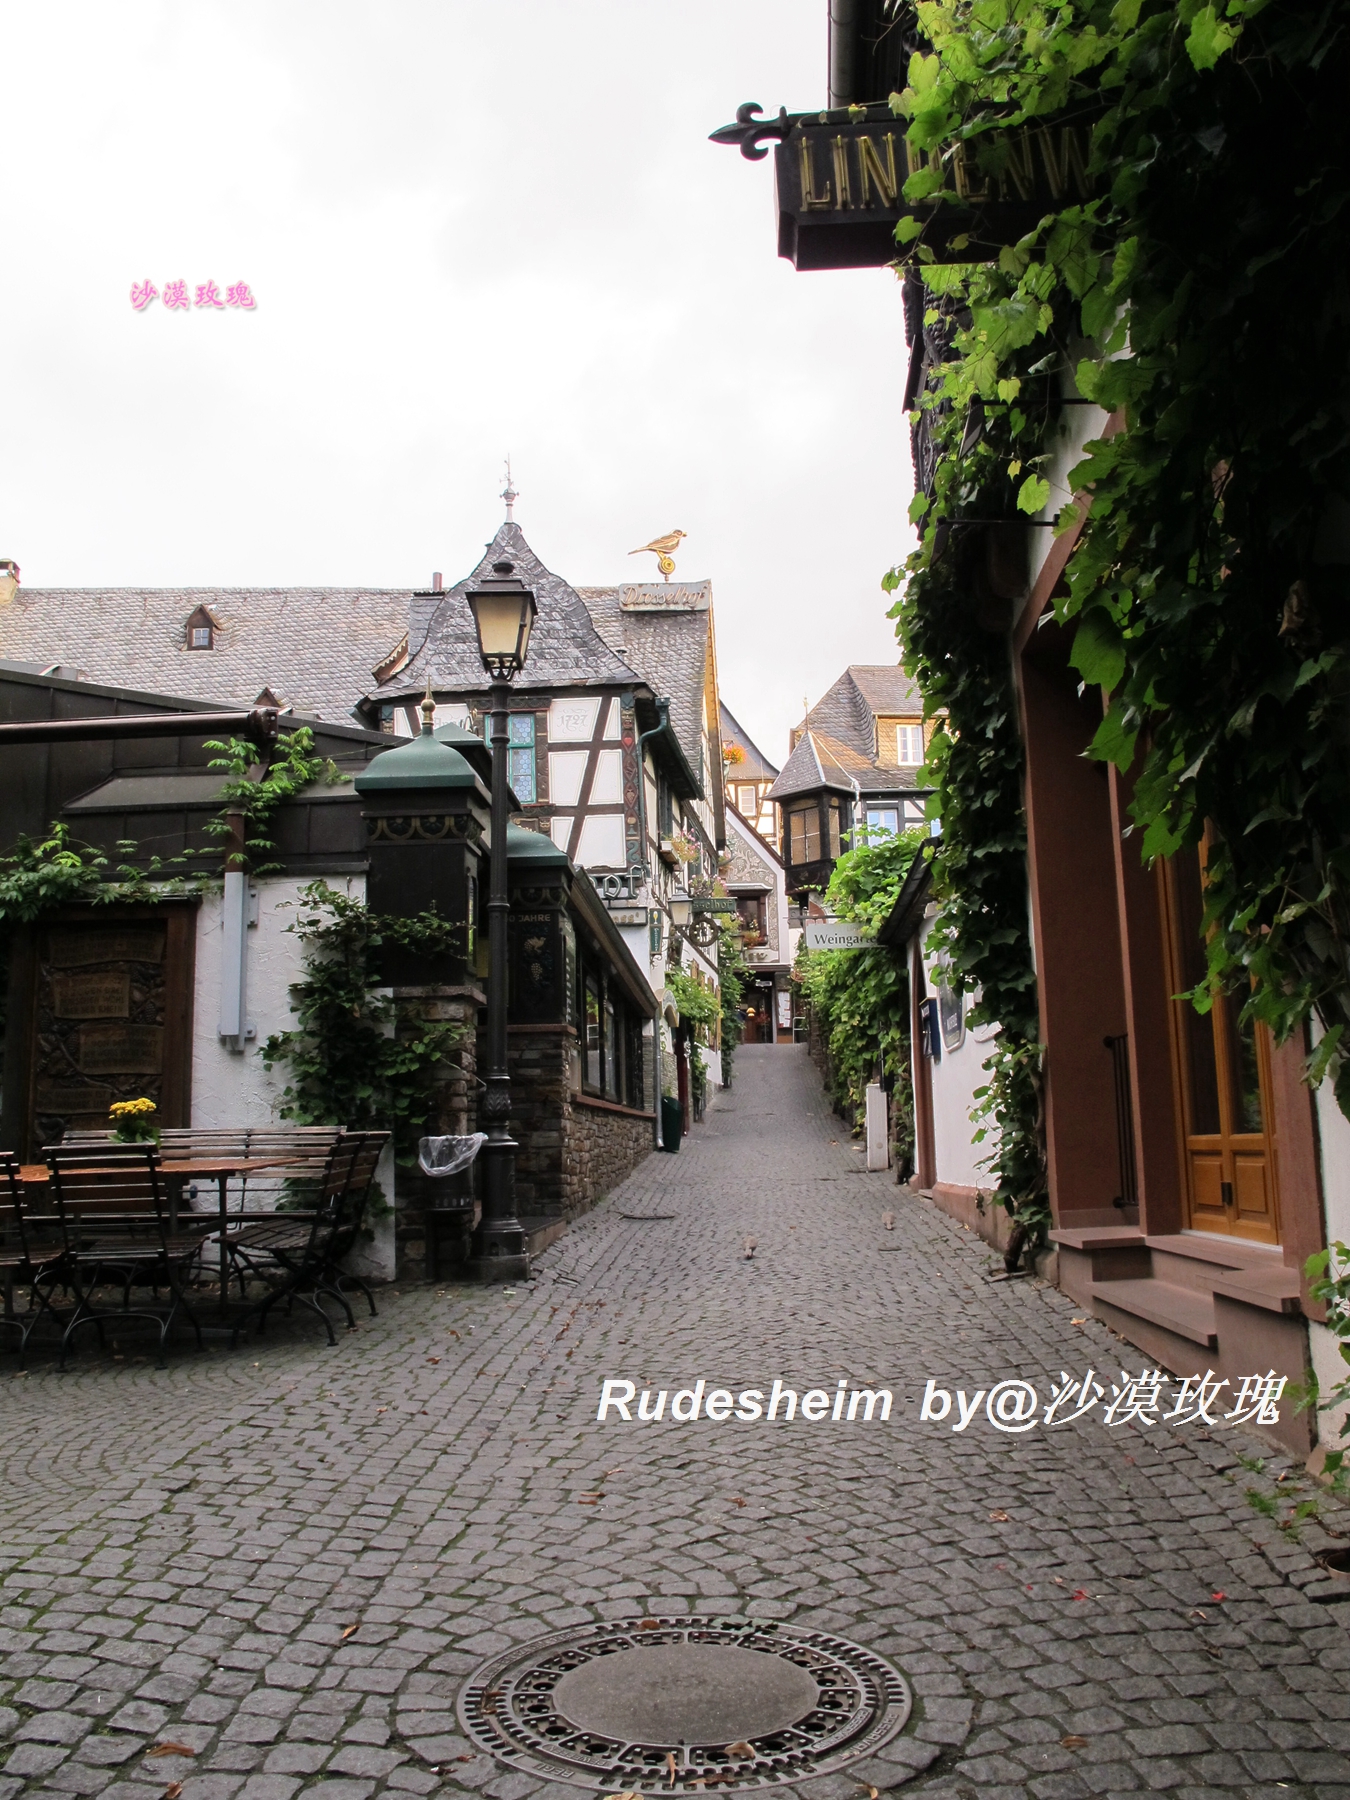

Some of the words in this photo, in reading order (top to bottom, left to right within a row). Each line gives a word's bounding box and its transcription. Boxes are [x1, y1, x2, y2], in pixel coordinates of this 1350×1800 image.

[621, 585, 703, 607] Drosselhof
[557, 714, 588, 731] 1727
[589, 865, 649, 900] of
[518, 913, 551, 923] JAHRE
